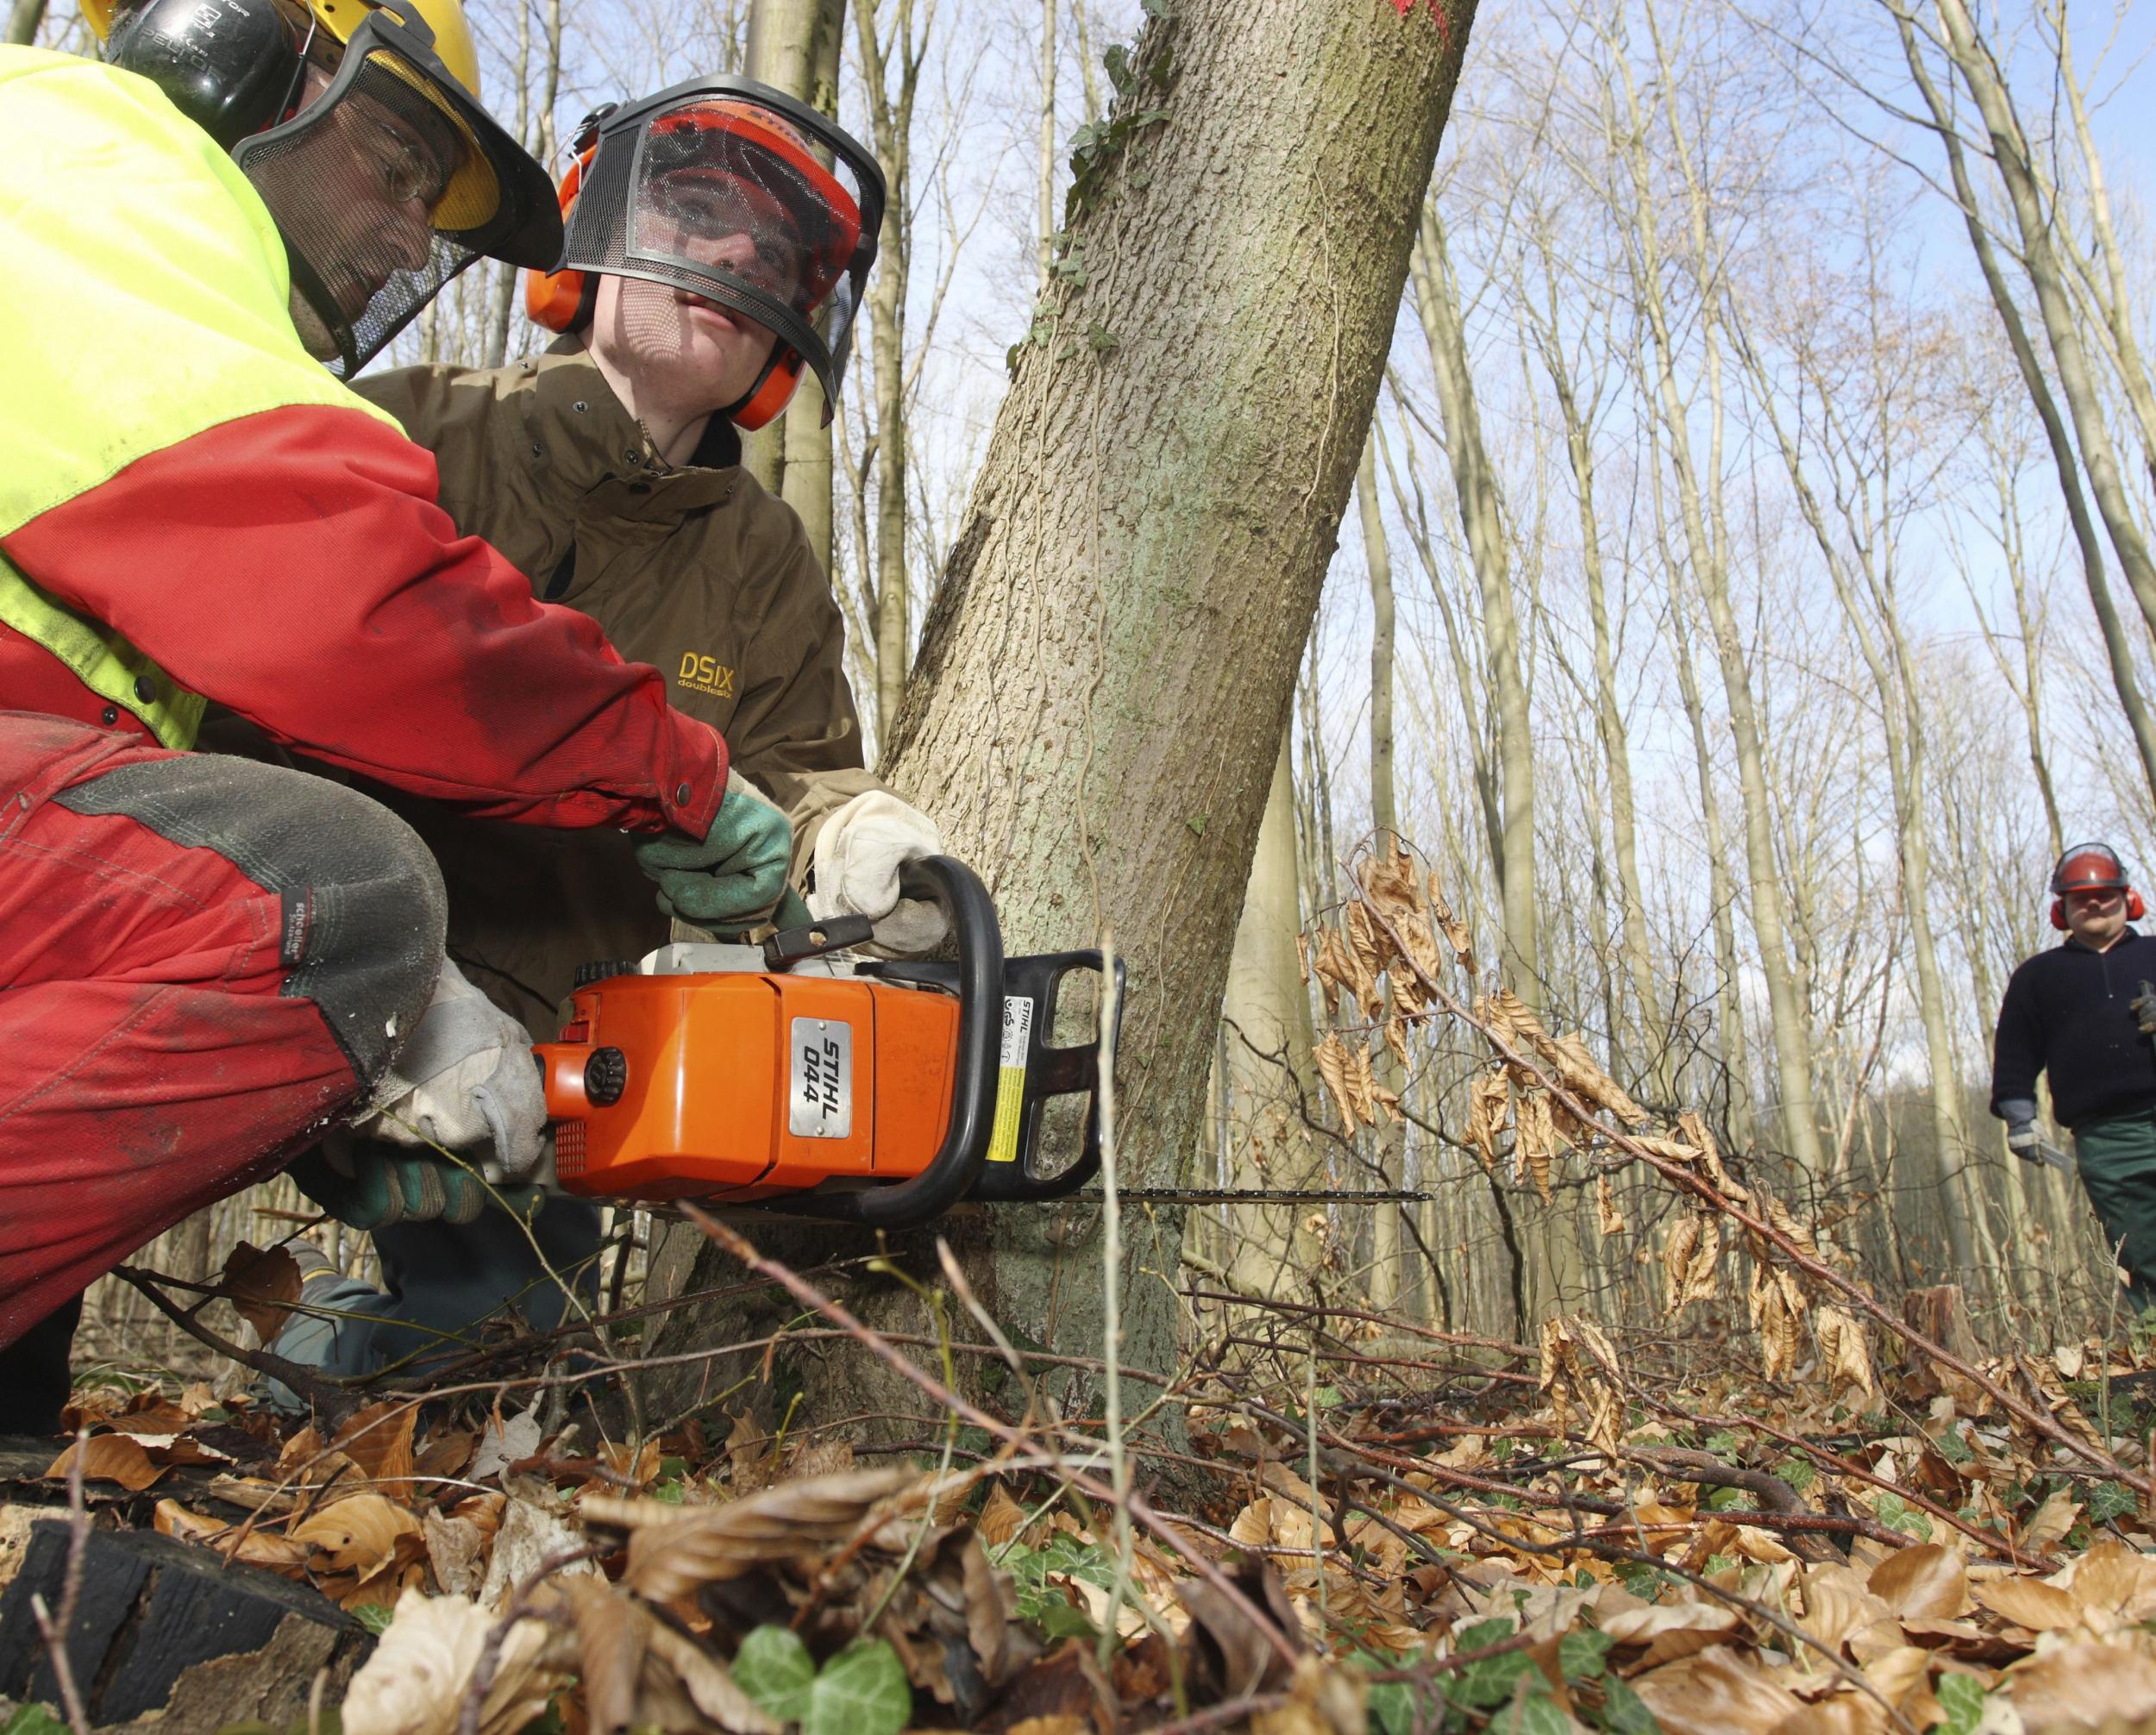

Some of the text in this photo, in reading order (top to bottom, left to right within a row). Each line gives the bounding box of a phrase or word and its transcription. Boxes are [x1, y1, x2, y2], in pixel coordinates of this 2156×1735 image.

[679, 651, 734, 691] DSIX
[291, 902, 306, 953] schoeller
[1019, 1000, 1031, 1033] STIHL
[804, 1045, 820, 1104] 044
[822, 1037, 839, 1120] STIHL
